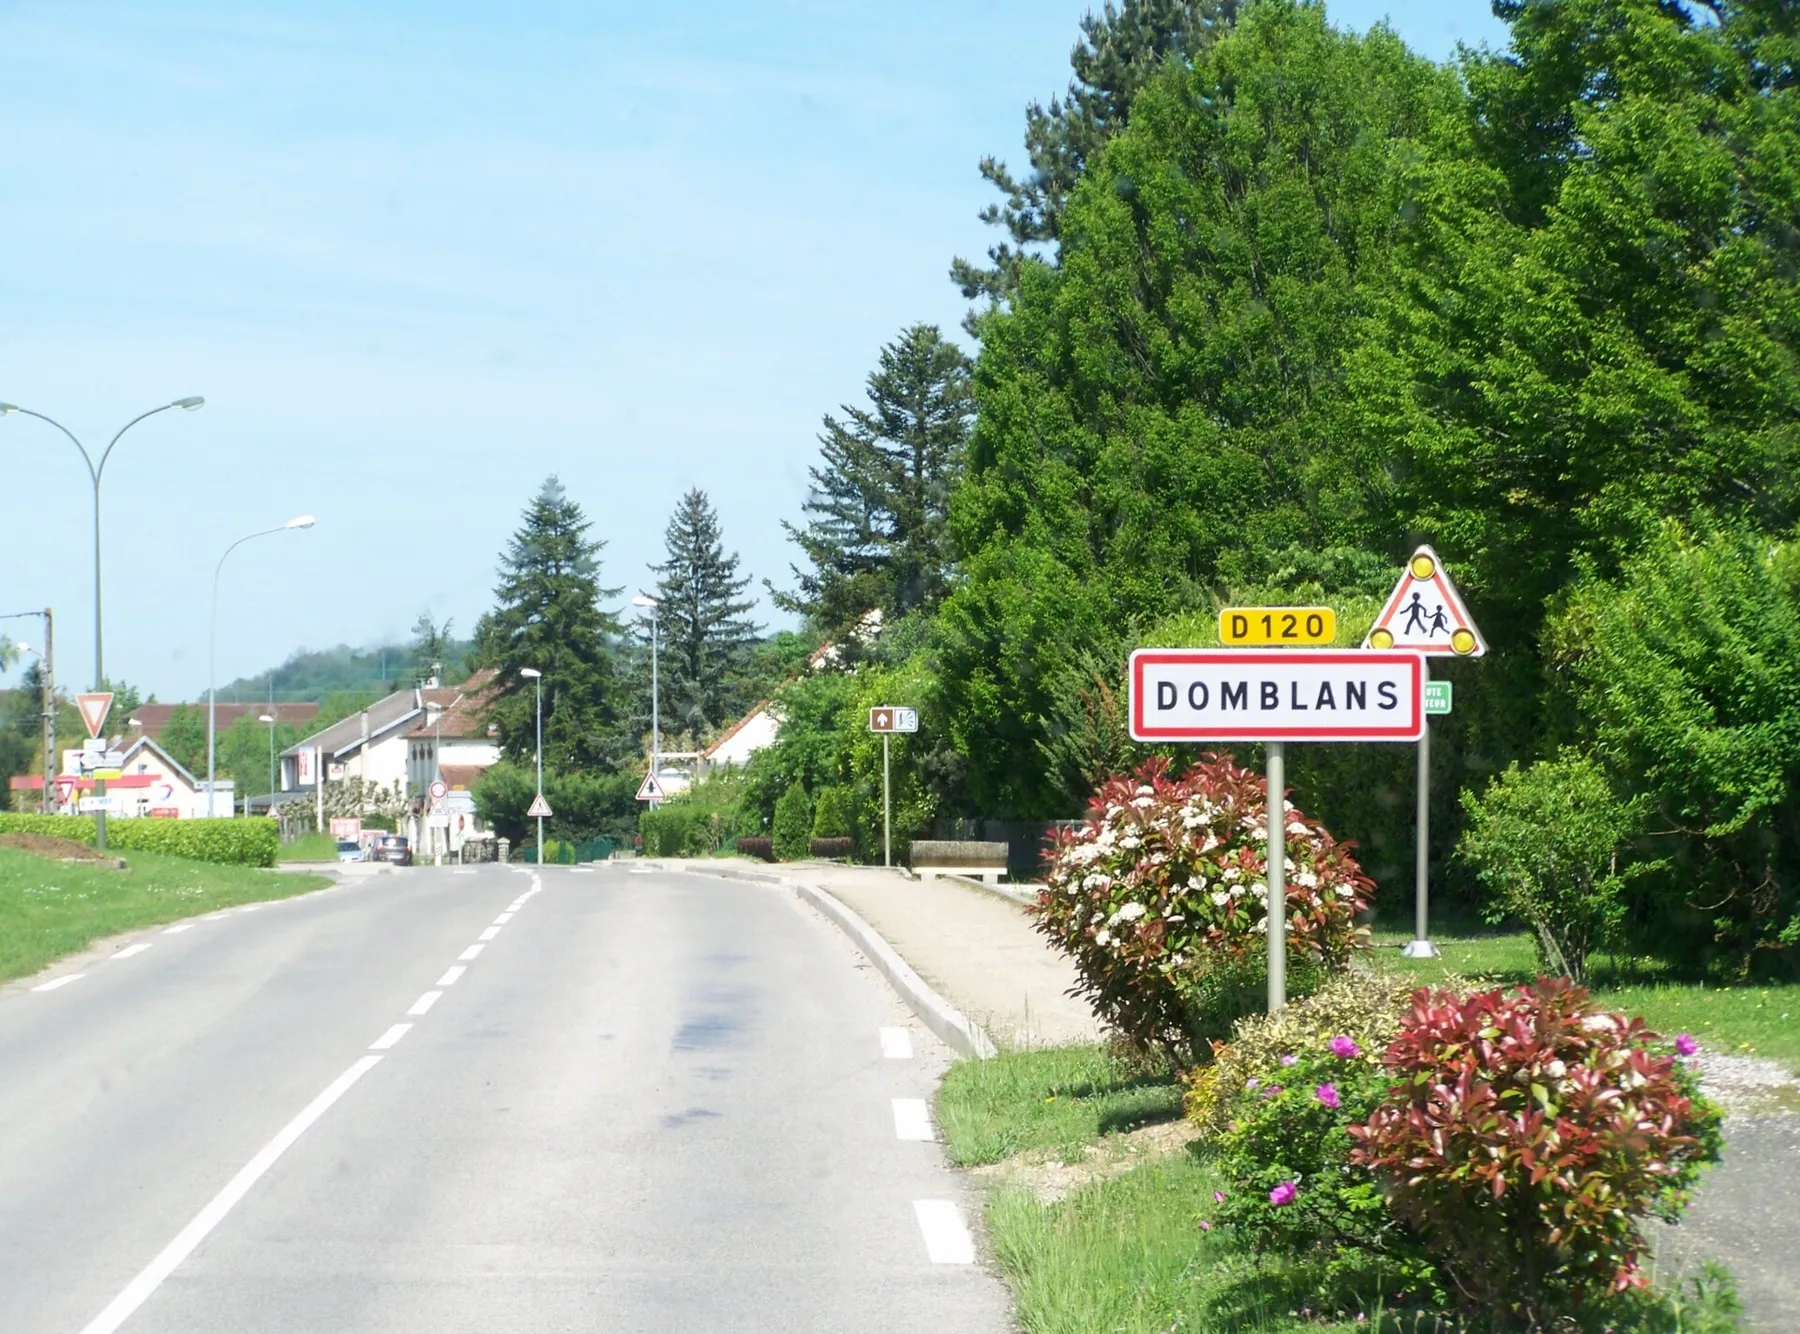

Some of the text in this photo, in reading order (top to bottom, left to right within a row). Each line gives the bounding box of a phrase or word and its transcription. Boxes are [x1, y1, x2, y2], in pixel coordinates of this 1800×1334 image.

[1232, 614, 1323, 638] D 120
[1157, 680, 1399, 711] DOMBLANS
